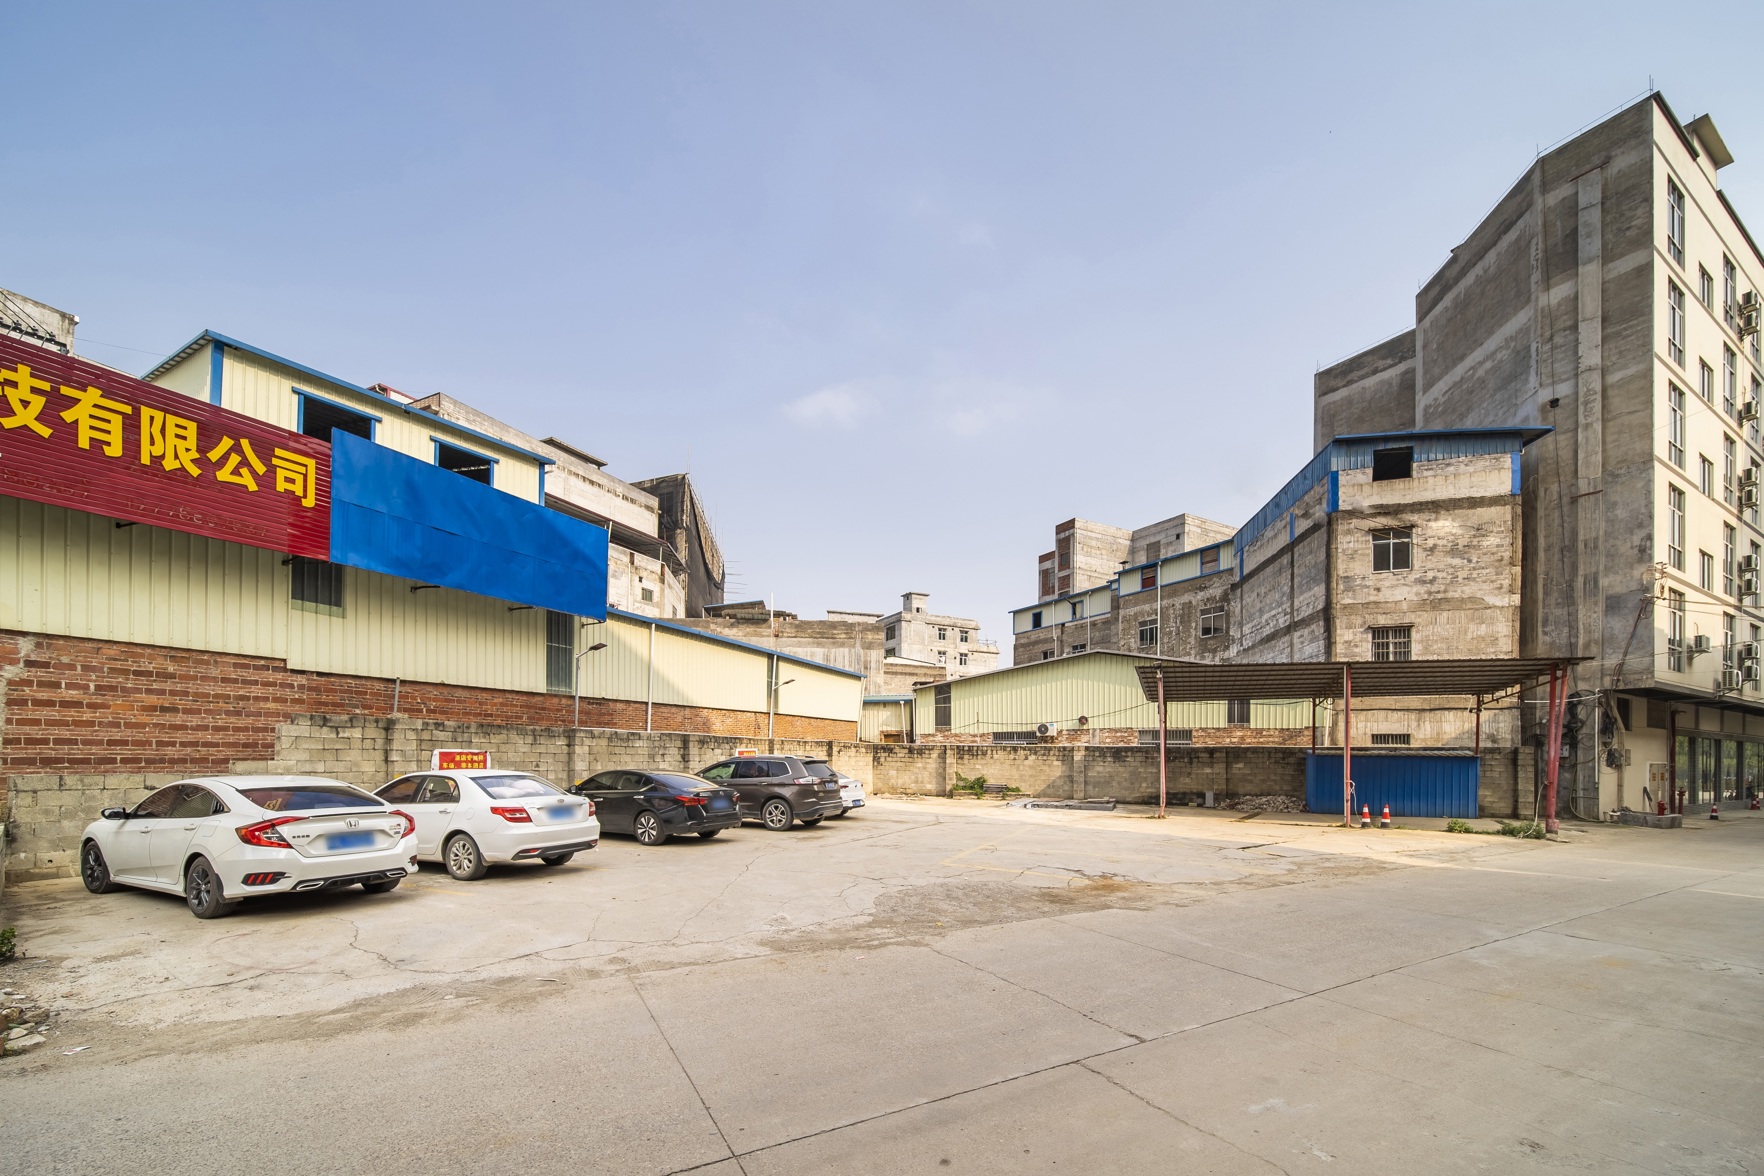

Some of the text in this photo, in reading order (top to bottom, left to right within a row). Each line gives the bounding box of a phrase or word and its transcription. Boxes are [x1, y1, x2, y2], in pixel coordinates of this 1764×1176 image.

[0, 363, 317, 508] 技有限公司
